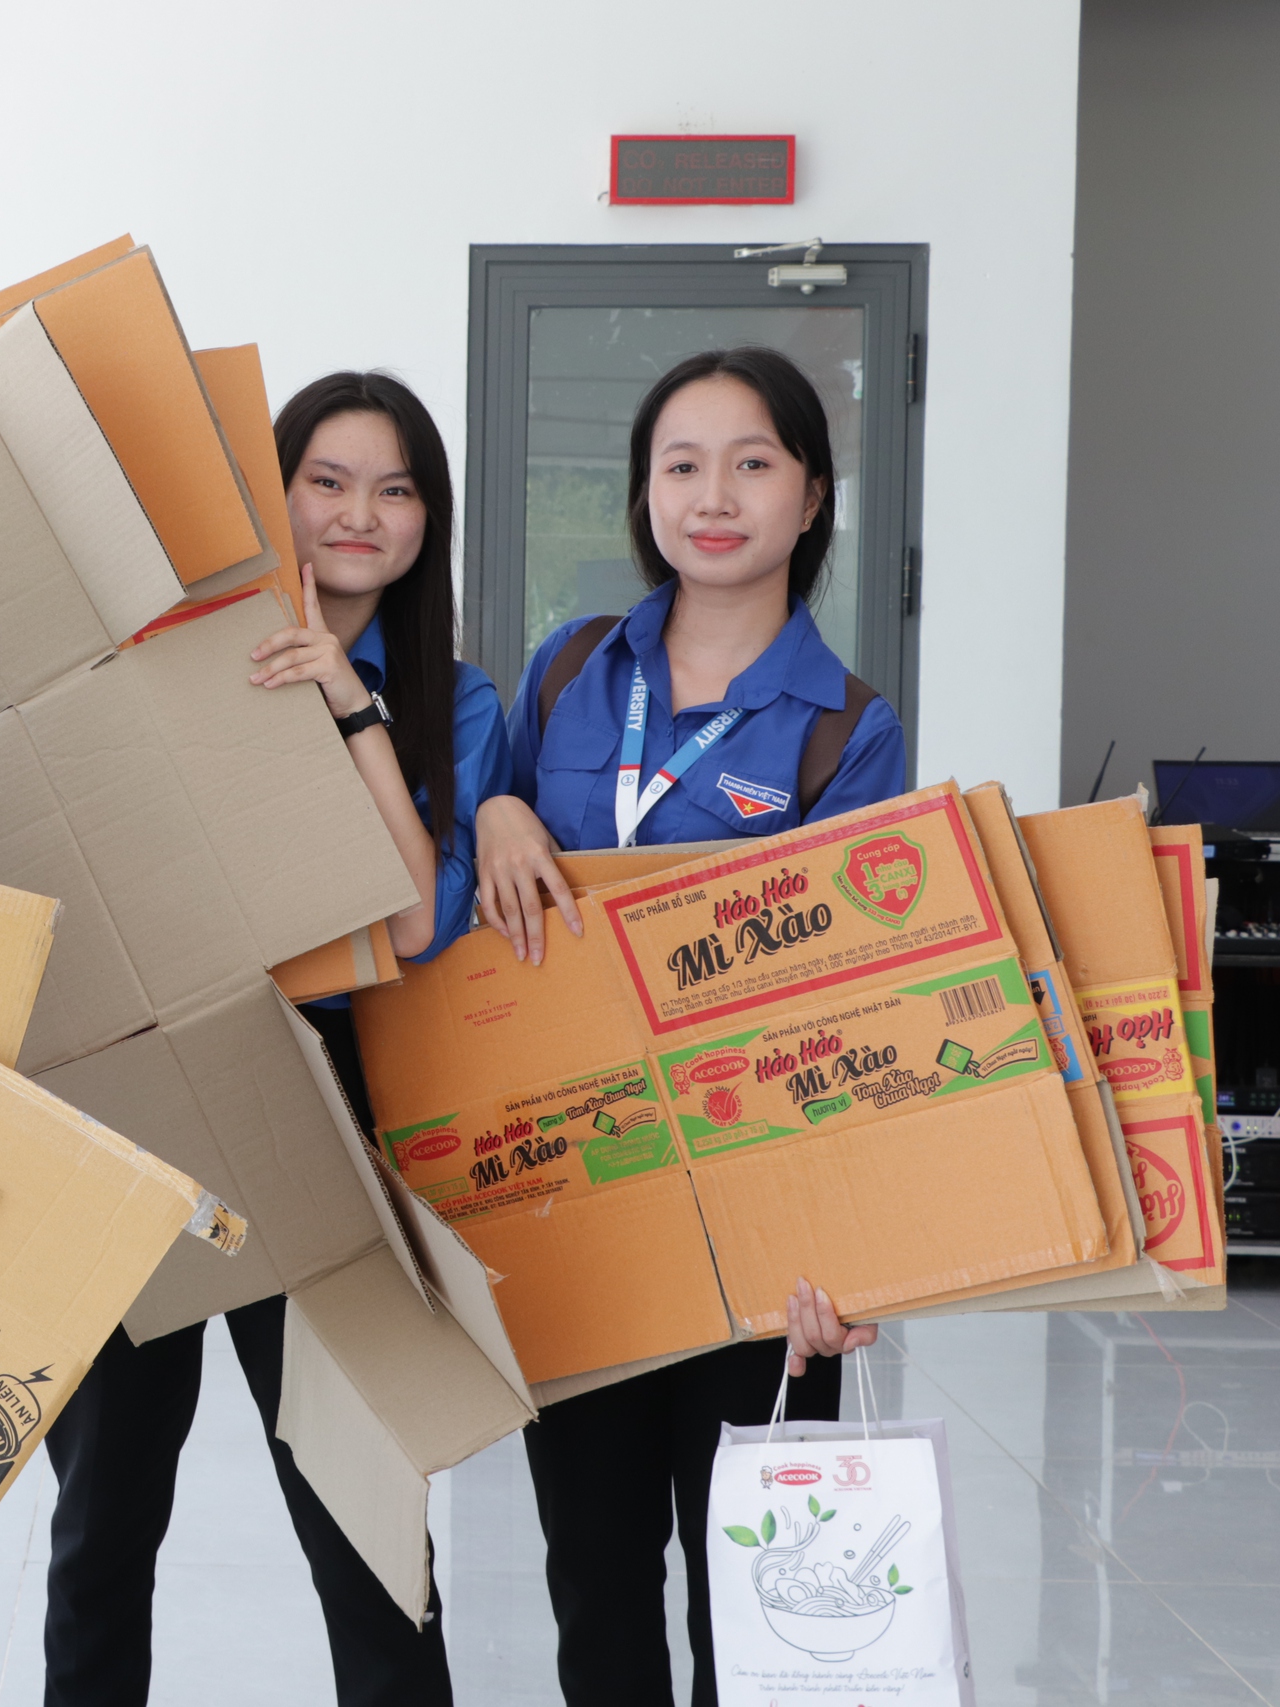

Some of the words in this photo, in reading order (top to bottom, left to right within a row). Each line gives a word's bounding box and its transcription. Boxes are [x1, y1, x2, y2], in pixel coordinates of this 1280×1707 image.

[675, 152, 785, 170] RELEASED
[622, 177, 653, 194] DO
[663, 177, 707, 194] NOT
[717, 177, 785, 194] ENTER
[723, 778, 743, 792] THANH
[771, 795, 786, 806] NAM
[856, 848, 881, 861] Cung
[878, 865, 916, 883] CANXI
[623, 908, 645, 924] THỰC
[645, 896, 670, 916] PHẨM
[669, 892, 683, 908] BỔ
[684, 889, 707, 904] SUNG
[707, 884, 763, 929] Hảo
[755, 862, 812, 908] Hảo
[662, 929, 738, 992] Mì
[727, 890, 838, 966] Xào
[669, 994, 690, 1007] Thông
[691, 992, 700, 1000] tin
[701, 988, 717, 999] cung
[717, 982, 730, 993] cấp
[731, 980, 743, 989] 1/3
[743, 976, 756, 985] nhu
[770, 966, 788, 978] canxi
[789, 961, 806, 973] hàng
[827, 950, 843, 961] được
[844, 946, 857, 956] xác
[857, 942, 873, 953] định
[874, 938, 887, 948] cho
[888, 932, 908, 944] nhóm
[909, 926, 928, 939] người
[937, 917, 958, 930] thành
[662, 1005, 683, 1017] trưởng
[684, 999, 703, 1010] thành
[704, 996, 712, 1005] có
[713, 991, 728, 1002] mức
[729, 988, 742, 997] nhu
[756, 979, 773, 990] canxi
[815, 964, 822, 973] là
[823, 959, 843, 970] 1.000
[844, 950, 874, 966] mg/ngày
[875, 945, 890, 956] theo
[891, 939, 913, 953] Thông
[1124, 993, 1135, 1003] (30
[1137, 991, 1146, 1001] kg
[761, 1028, 778, 1042] SẢN
[777, 1021, 801, 1038] PHẨM
[800, 1018, 816, 1032] VỚI
[815, 1012, 838, 1028] CÔNG
[838, 1006, 861, 1023] NGHỆ
[861, 1000, 883, 1016] NHẬT
[883, 994, 901, 1009] BẢN
[1113, 1007, 1177, 1052] Hảo
[683, 1054, 704, 1068] Cook
[703, 1042, 746, 1062] happiness
[750, 1043, 801, 1084] Hảo
[794, 1024, 846, 1066] Hảo
[782, 1062, 834, 1105] Mì
[826, 1037, 901, 1087] Xào
[879, 1063, 916, 1092] Xào
[504, 1099, 520, 1112] SẢN
[520, 1092, 542, 1107] PHẨM
[542, 1091, 555, 1101] VỚI
[555, 1085, 577, 1097] CÔNG
[577, 1077, 599, 1092] NGHỆ
[600, 1072, 621, 1086] NHẬT
[621, 1066, 638, 1079] BẢN
[602, 1086, 627, 1105] Chua
[714, 1082, 731, 1094] NAM
[871, 1084, 910, 1110] Chua
[904, 1070, 943, 1100] Ngọt
[811, 1100, 837, 1117] hương
[837, 1096, 847, 1107] vị
[403, 1131, 422, 1146] Cook
[421, 1122, 458, 1140] happiness
[470, 1127, 505, 1157] Hảo
[500, 1114, 536, 1144] Hảo
[466, 1152, 512, 1192] Mì
[504, 1129, 571, 1176] Xào
[473, 1186, 507, 1199] ACECOOK
[507, 1180, 525, 1191] VIỆT
[526, 1176, 543, 1186] NAM
[1138, 1182, 1178, 1221] Hả
[14, 1404, 35, 1425] ĂN
[773, 1463, 787, 1471] Cook
[789, 1461, 821, 1470] happiness
[909, 1667, 936, 1679] Nam
